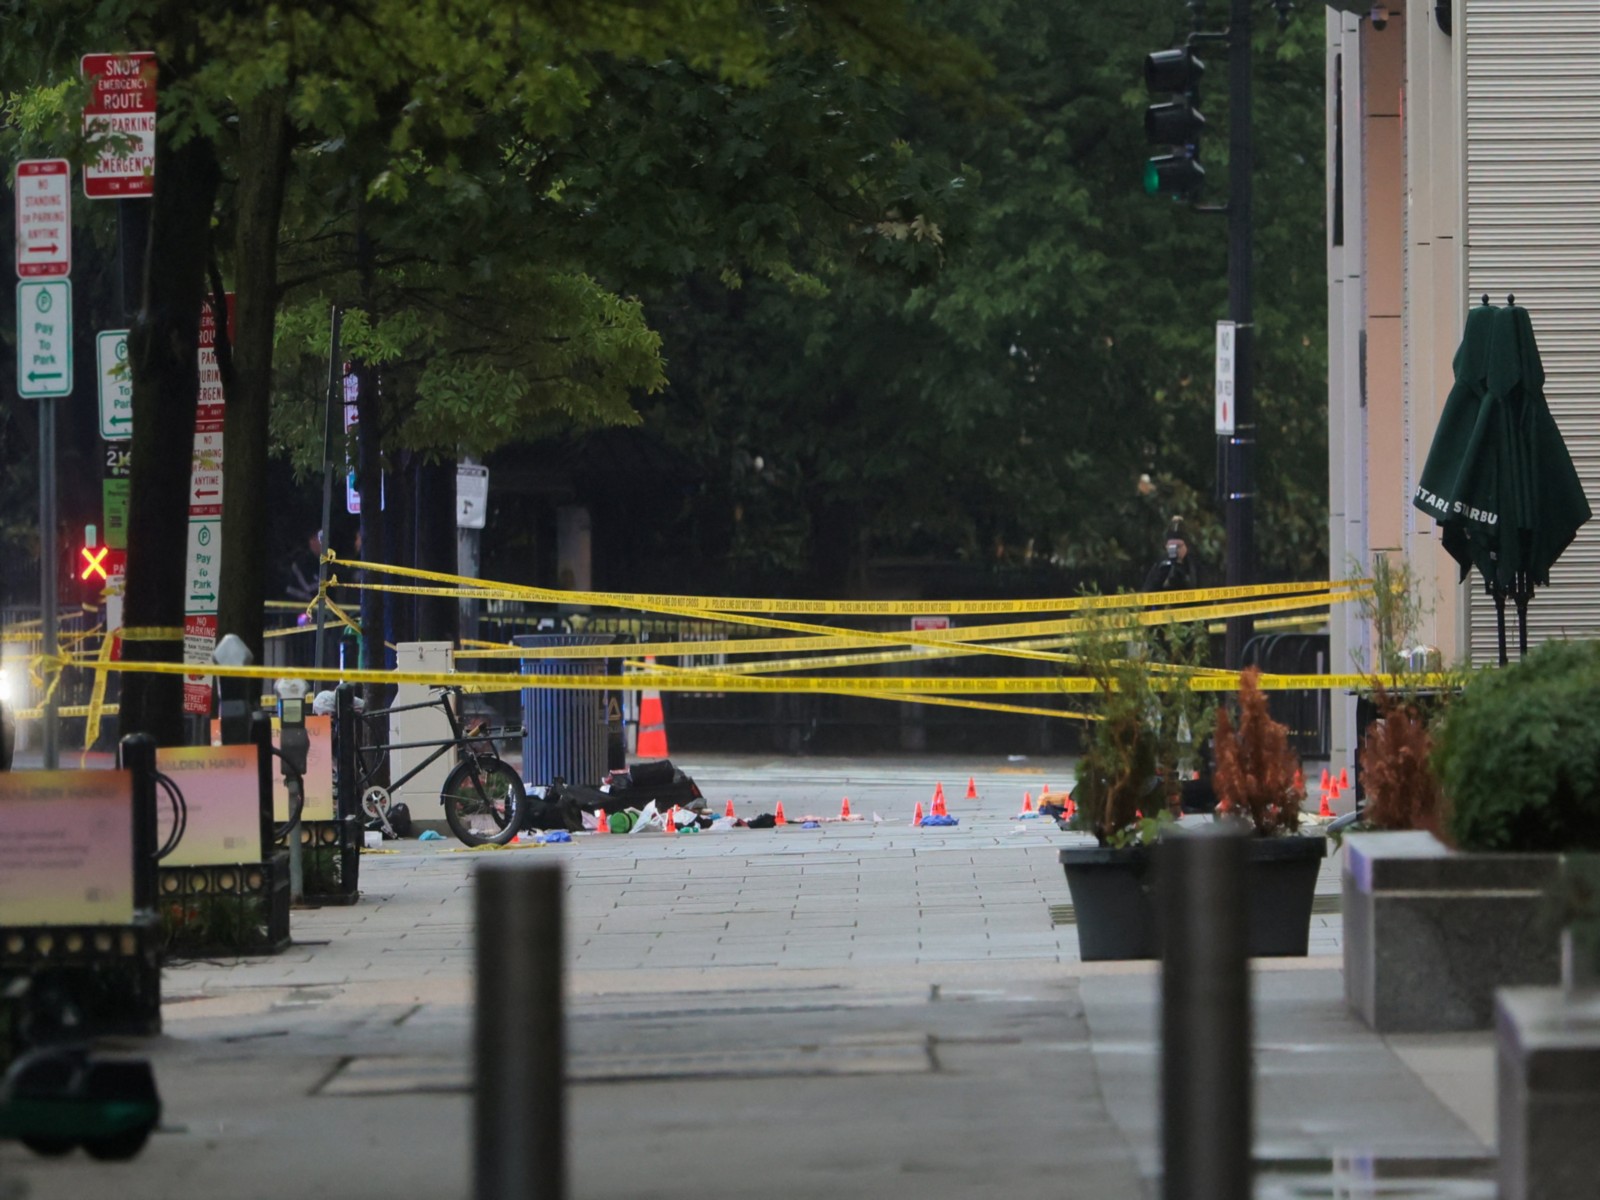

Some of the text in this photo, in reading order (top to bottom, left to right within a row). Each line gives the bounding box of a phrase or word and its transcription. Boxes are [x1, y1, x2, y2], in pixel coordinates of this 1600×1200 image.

[105, 60, 141, 76] SNOW
[98, 80, 147, 91] EMERGENCY
[103, 93, 144, 110] ROUTE
[111, 117, 156, 133] PARKING
[35, 323, 54, 336] Pay
[40, 340, 51, 351] To
[33, 355, 56, 366] Park
[113, 399, 130, 409] Par
[203, 436, 212, 444] NO
[194, 476, 219, 485] ANYTIME
[196, 553, 211, 566] Pay
[193, 580, 212, 589] Park
[197, 616, 207, 627] NO
[186, 625, 216, 637] PARKING
